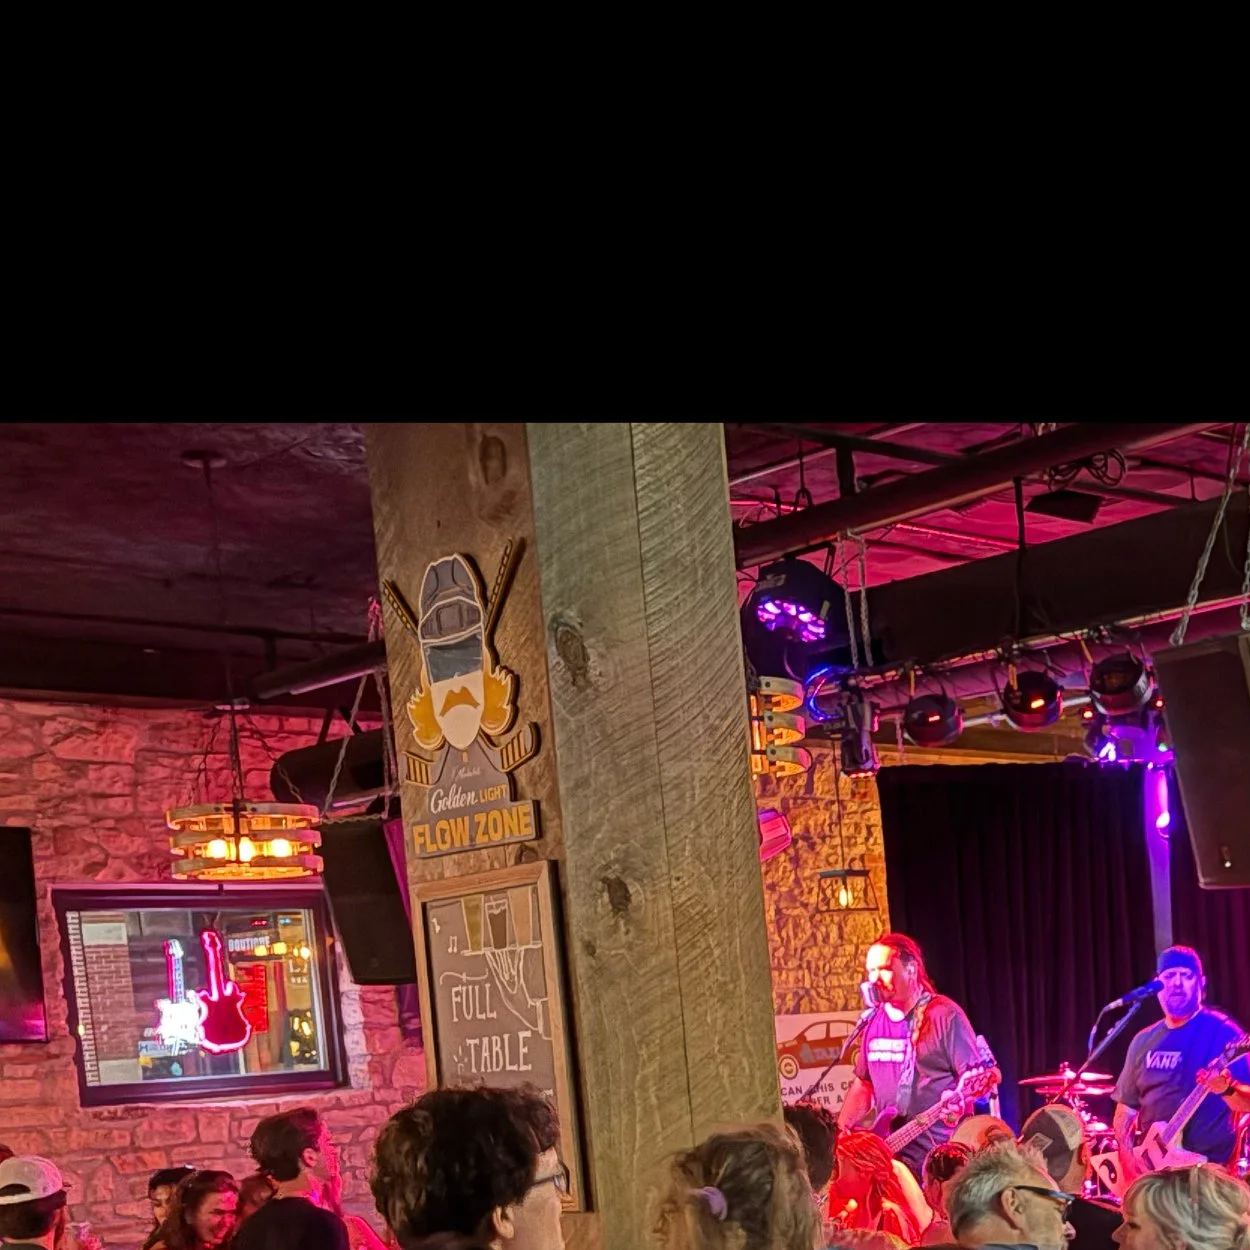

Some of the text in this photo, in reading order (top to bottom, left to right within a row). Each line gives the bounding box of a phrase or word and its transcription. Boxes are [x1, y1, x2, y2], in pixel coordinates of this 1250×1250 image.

[430, 783, 508, 815] Golden LIGHT
[412, 804, 533, 855] FLOW ZONE
[451, 982, 497, 1022] FULL
[466, 1030, 532, 1073] TABLE
